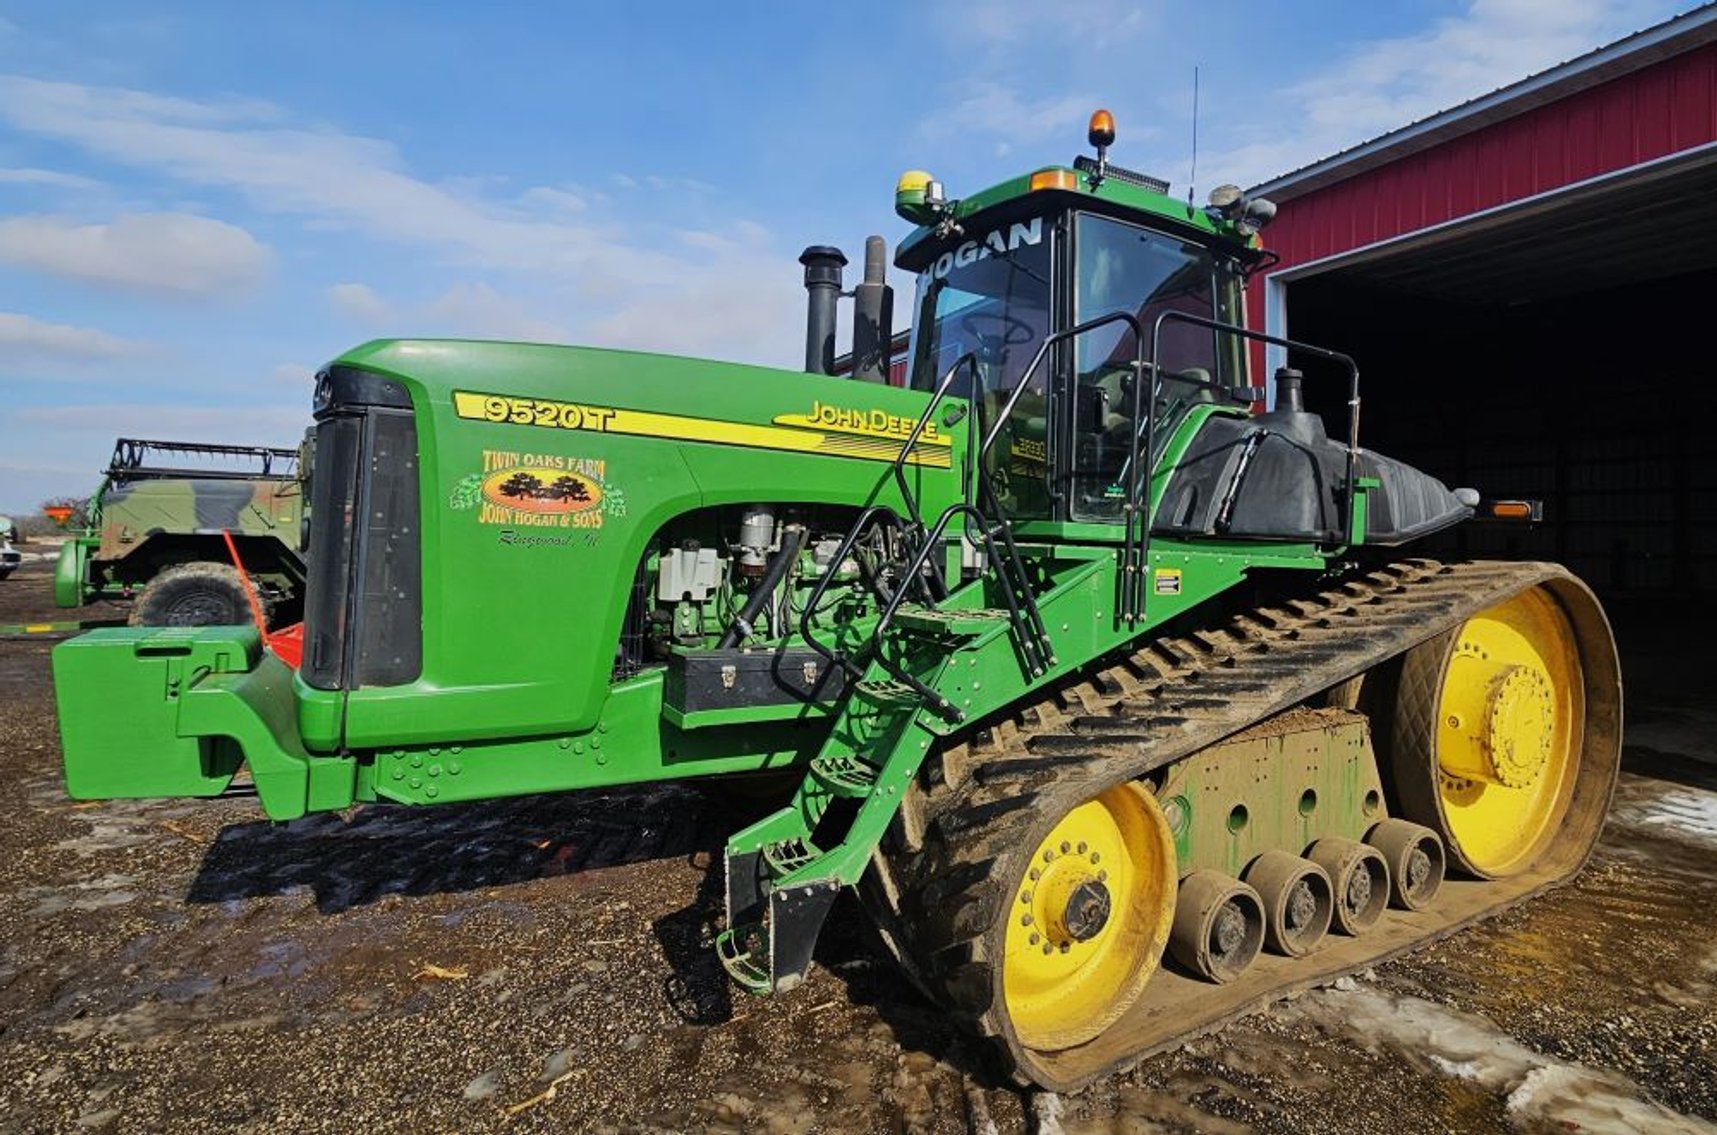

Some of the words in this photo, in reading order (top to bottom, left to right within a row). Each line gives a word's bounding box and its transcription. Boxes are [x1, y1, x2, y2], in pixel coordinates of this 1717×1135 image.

[484, 397, 615, 433] 9520T
[807, 400, 869, 430] JOHN
[482, 449, 520, 473] TWIN
[523, 453, 564, 469] OAKS
[567, 457, 605, 482] FARM
[478, 501, 513, 525] JOHN
[514, 511, 558, 527] HOGAN
[560, 515, 570, 528] &
[572, 508, 603, 529] SONS
